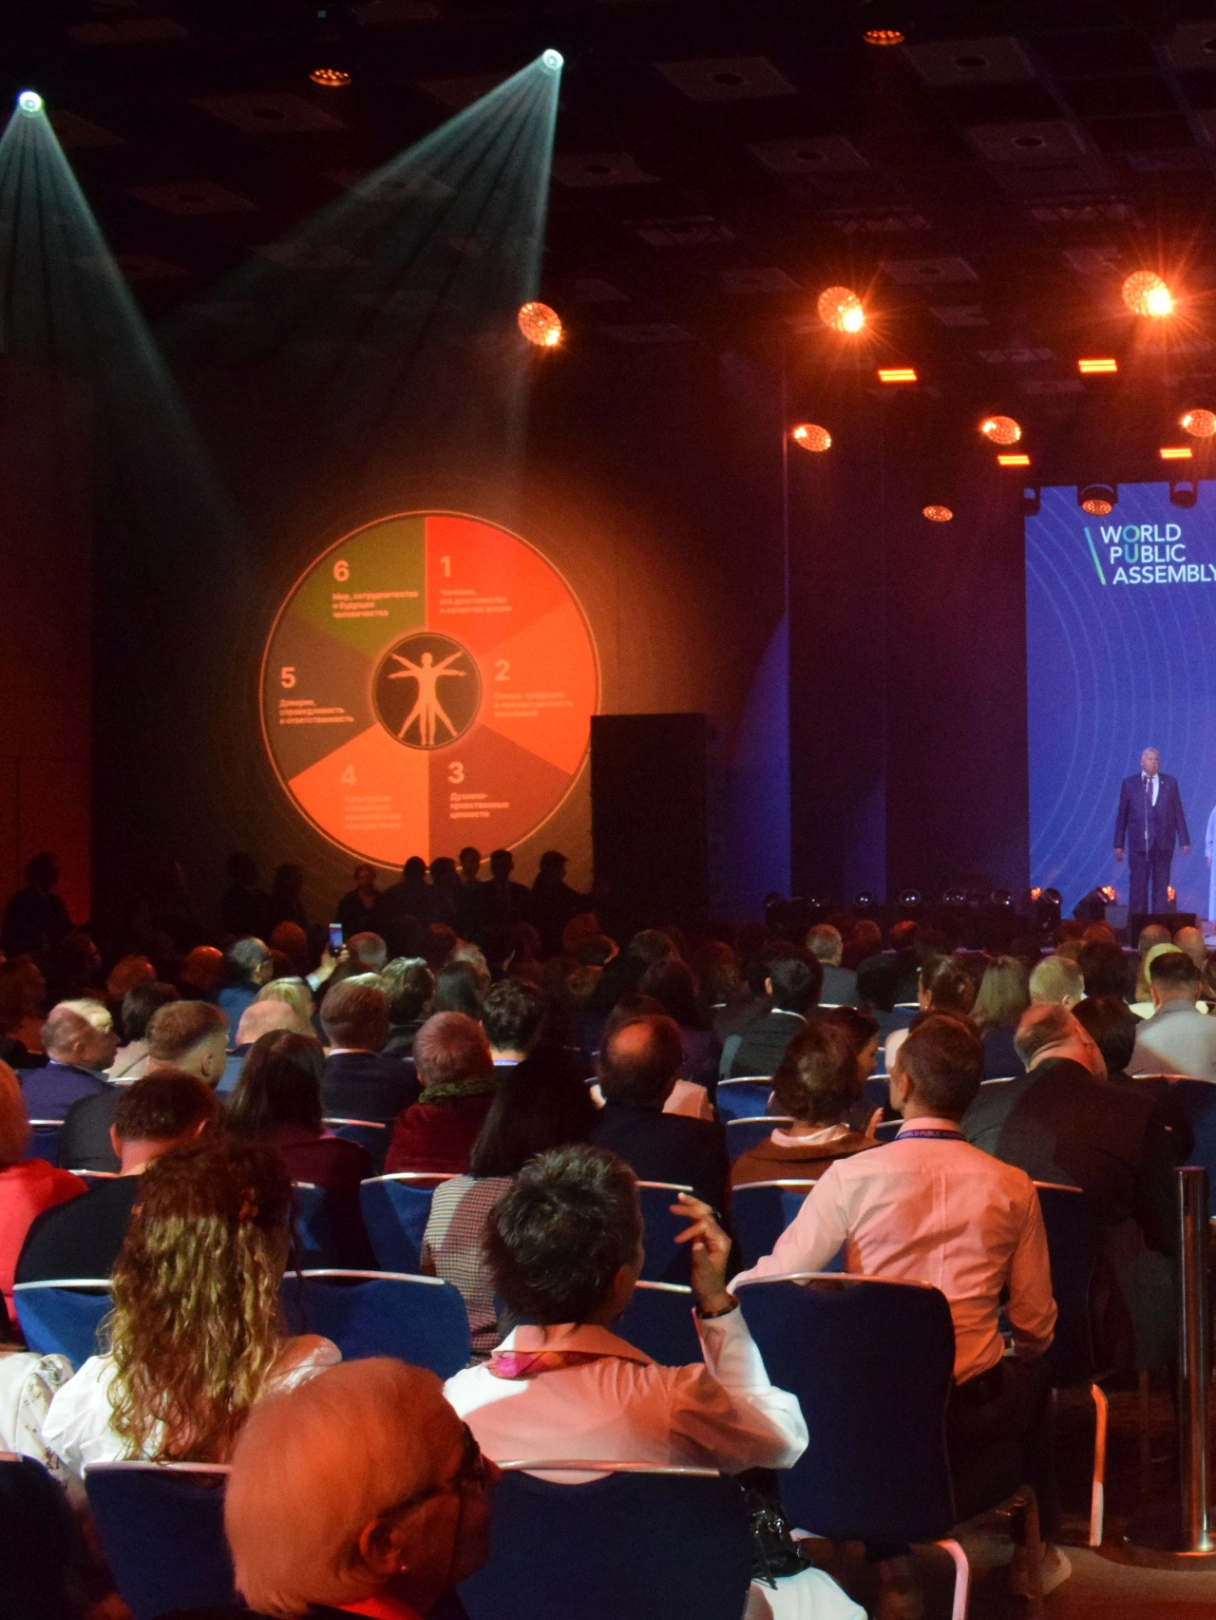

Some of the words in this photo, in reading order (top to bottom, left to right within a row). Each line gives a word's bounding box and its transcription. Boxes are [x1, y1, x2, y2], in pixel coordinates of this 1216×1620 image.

[1100, 523, 1182, 544] WORLD
[1110, 544, 1186, 565] PUBLIC
[333, 559, 350, 582] 6
[440, 555, 451, 578] 1
[280, 666, 296, 689] 5
[494, 659, 511, 681] 2
[340, 764, 357, 786] 4
[447, 761, 465, 784] 3
